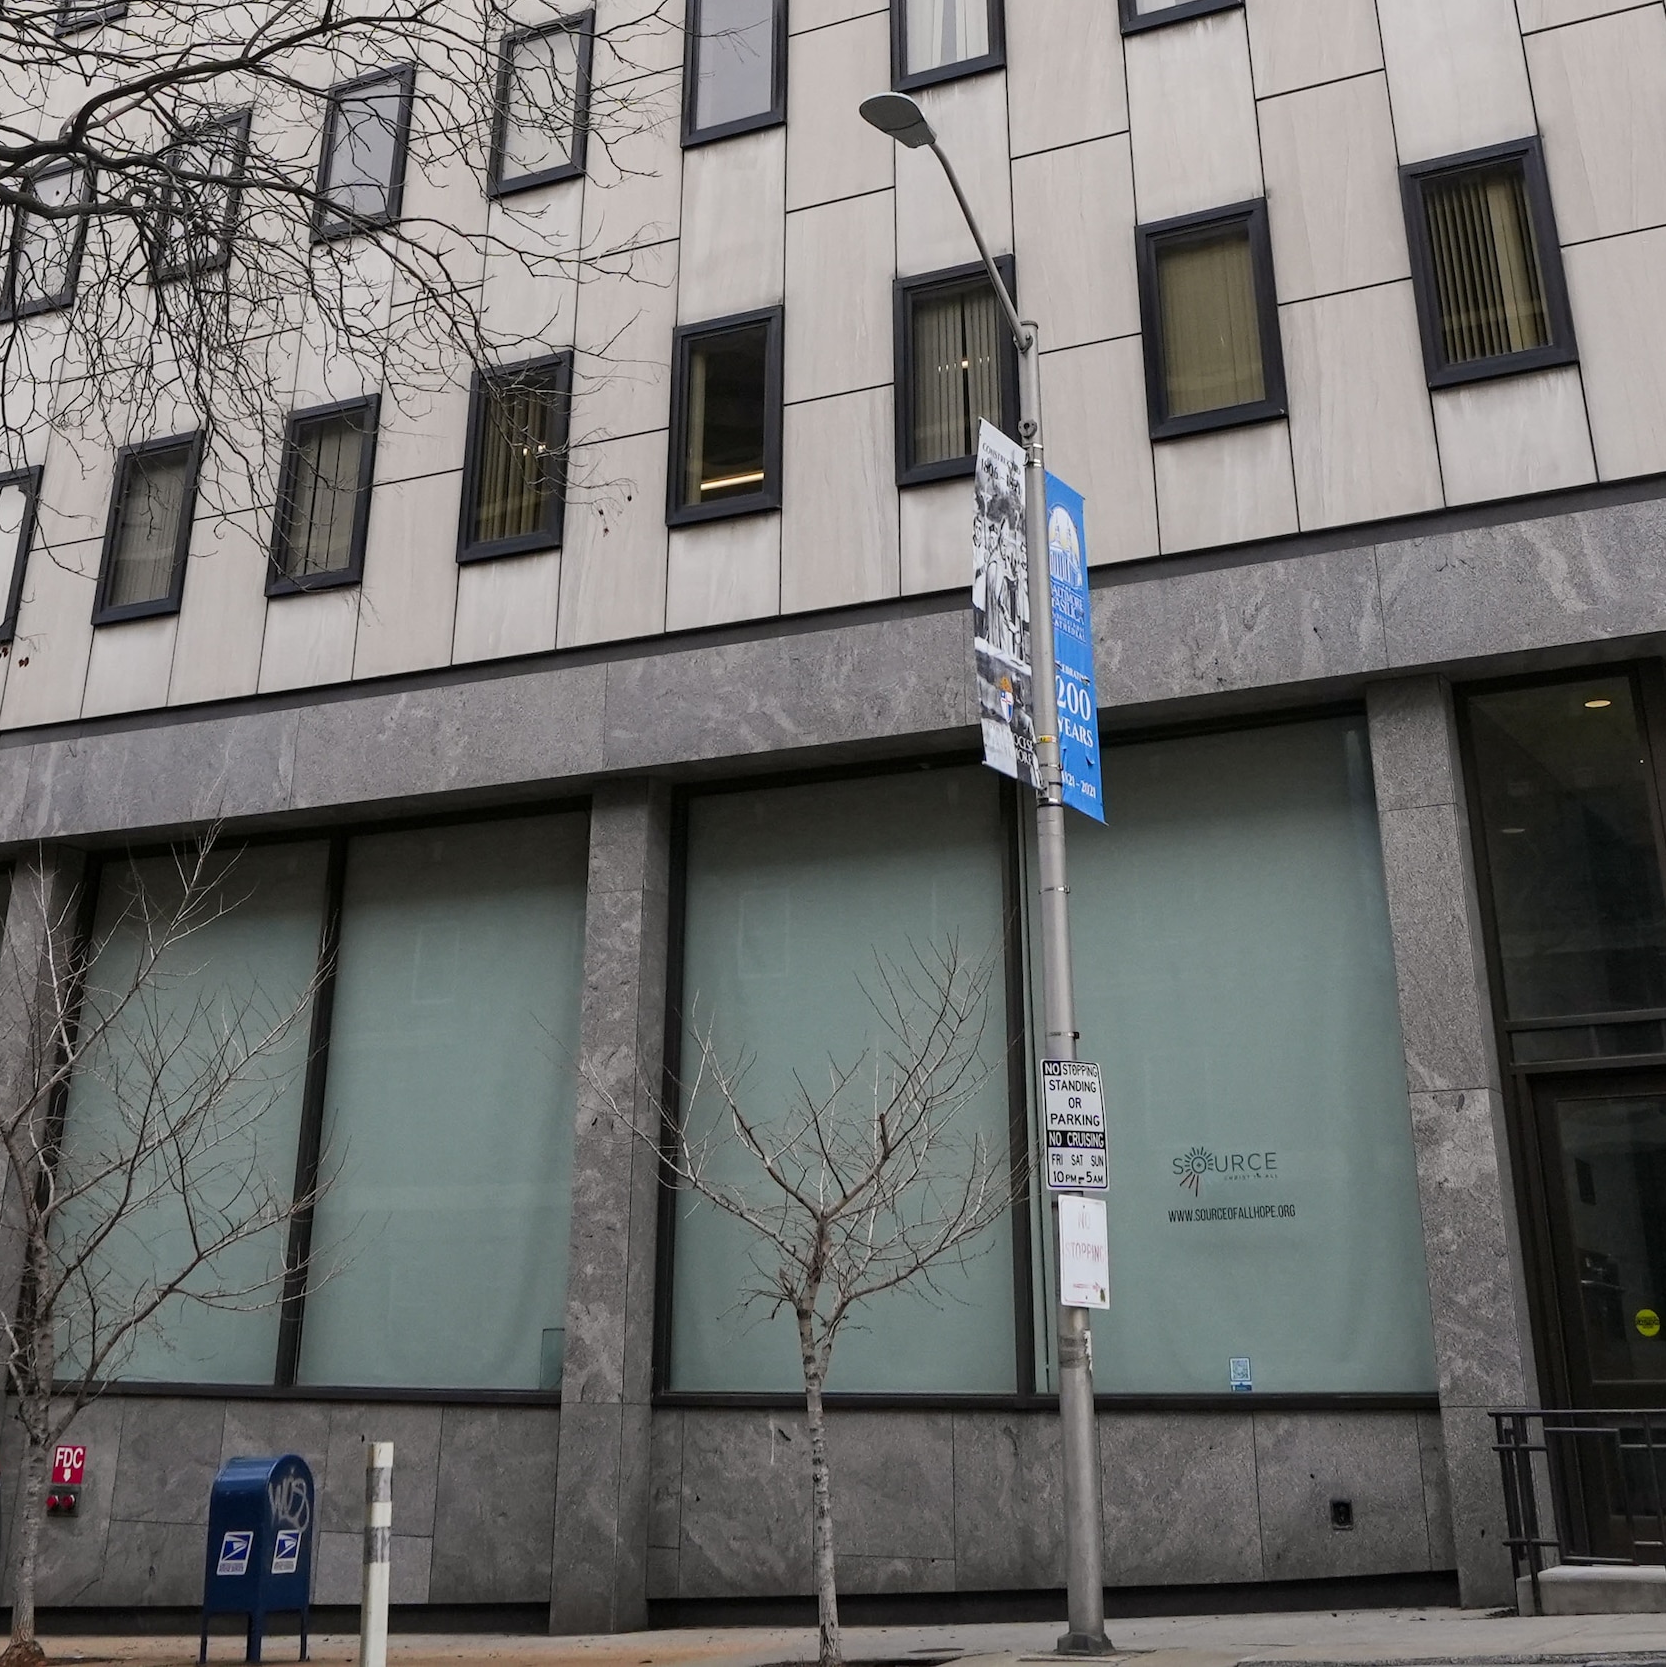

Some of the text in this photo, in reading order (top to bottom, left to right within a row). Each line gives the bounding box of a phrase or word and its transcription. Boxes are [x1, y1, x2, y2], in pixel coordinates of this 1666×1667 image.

[1050, 583, 1083, 611] ALTIMORE
[1053, 618, 1085, 641] ATHEDRAL
[1055, 675, 1091, 721] 200
[1058, 717, 1094, 748] YEARS
[1080, 780, 1096, 799] 2021
[1044, 1062, 1098, 1078] NO STOPPING
[1049, 1079, 1097, 1093] STANDING
[1068, 1097, 1082, 1109] OR
[1050, 1113, 1100, 1127] PARKING
[1048, 1131, 1104, 1148] NO CRUISING
[1052, 1153, 1104, 1167] FRI SAT SUN
[1172, 1152, 1278, 1175] SOURCE
[1168, 1205, 1296, 1223] WWW.SOURCEOFALLHOPE.ORG
[1065, 1241, 1104, 1263] STOPPING
[55, 1447, 83, 1469] FDC
